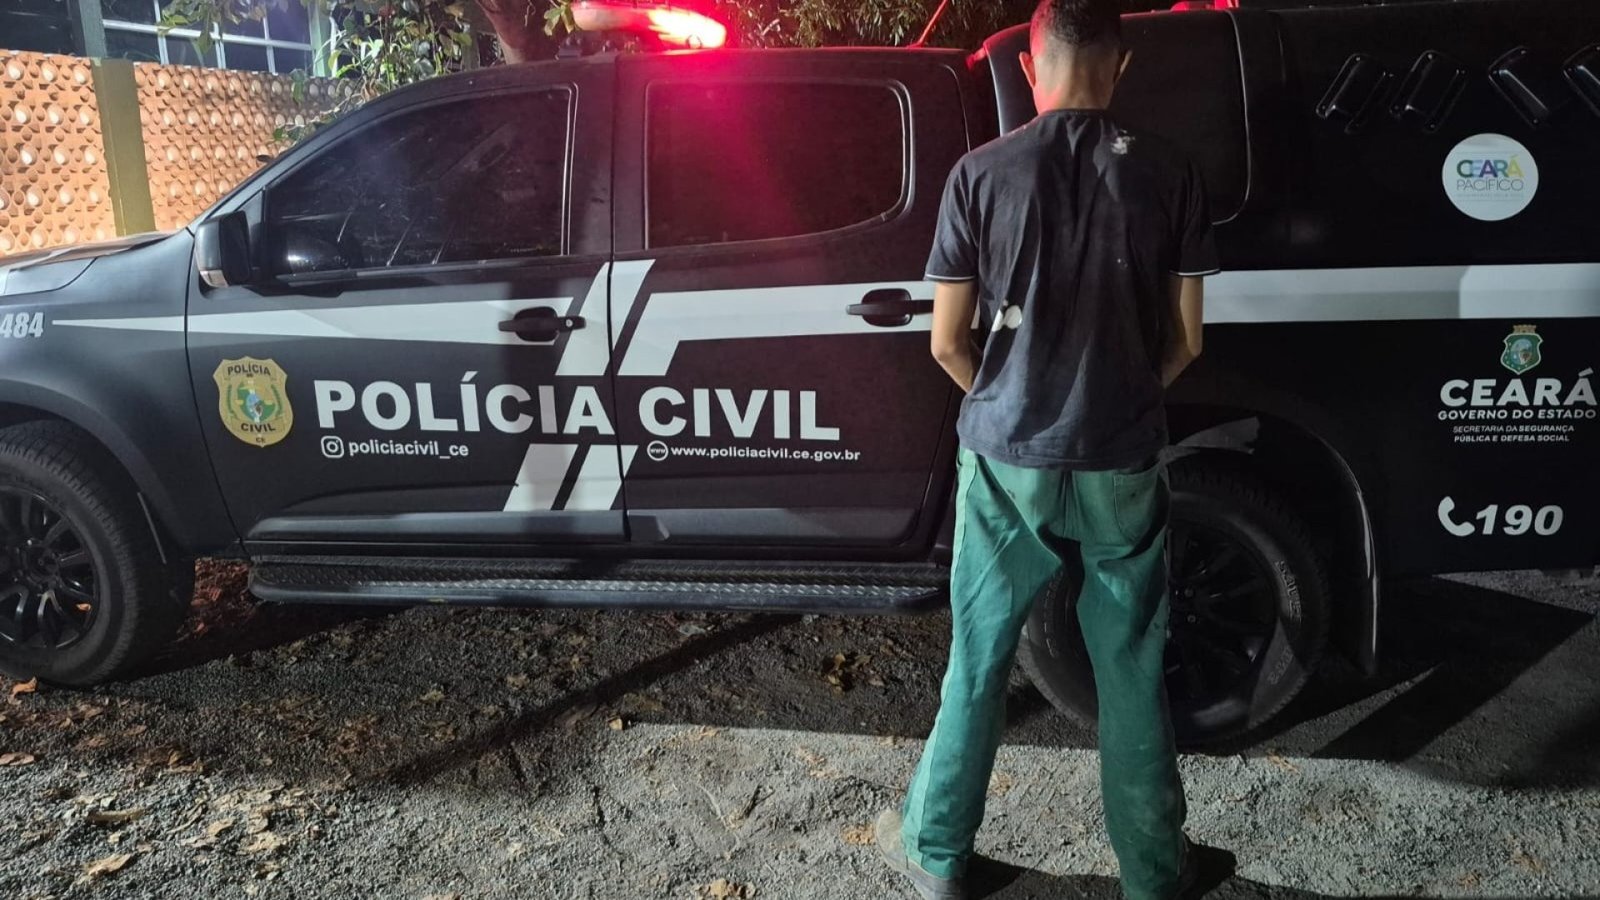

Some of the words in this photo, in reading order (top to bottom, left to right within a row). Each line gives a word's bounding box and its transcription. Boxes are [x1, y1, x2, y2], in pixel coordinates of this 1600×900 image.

[1456, 155, 1524, 178] CEARÁ
[0, 312, 44, 339] 484
[227, 362, 271, 376] POLÍCIA
[1440, 367, 1598, 407] CEARÁ
[314, 371, 615, 435] POLÍCIA
[638, 386, 840, 441] CIVIL
[1438, 410, 1508, 420] GOVERNO
[1512, 410, 1534, 419] DO
[1538, 409, 1597, 419] ESTADO
[240, 422, 276, 433] CIVIL
[1453, 425, 1504, 433] SECRETARIA
[1519, 425, 1574, 433] SEGURANÇA
[1454, 434, 1491, 442] PÚBLICA
[348, 440, 469, 459] policiacivil_ce
[670, 446, 861, 462] www.policiacivil.ce.gov.br
[1475, 504, 1564, 536] 190
